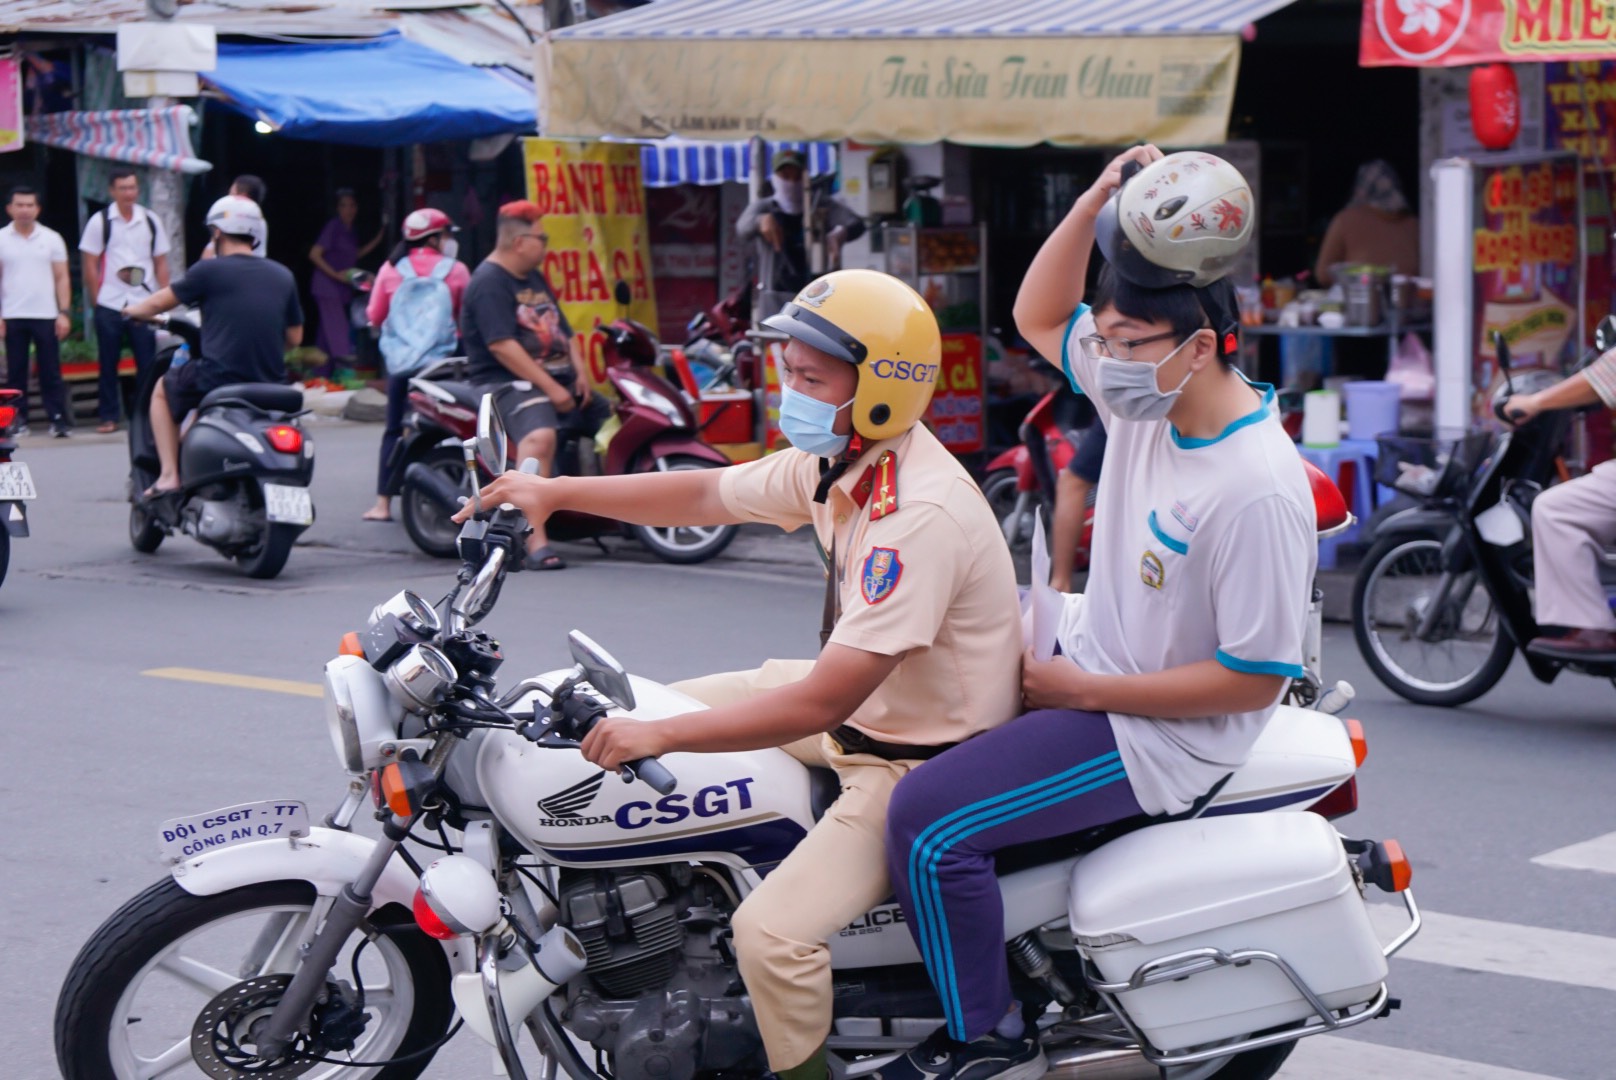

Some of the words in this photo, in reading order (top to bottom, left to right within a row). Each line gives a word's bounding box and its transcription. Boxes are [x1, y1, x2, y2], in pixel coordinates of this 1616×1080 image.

[543, 227, 610, 302] CHẢ
[873, 359, 938, 383] CSGT
[539, 815, 614, 827] HONDA
[615, 777, 754, 830] CSGT
[162, 823, 197, 842] ĐỘI
[202, 809, 253, 829] CSGT
[274, 805, 299, 816] TT
[182, 833, 226, 856] CÔNG
[231, 827, 252, 840] AN
[257, 823, 283, 836] Q.7
